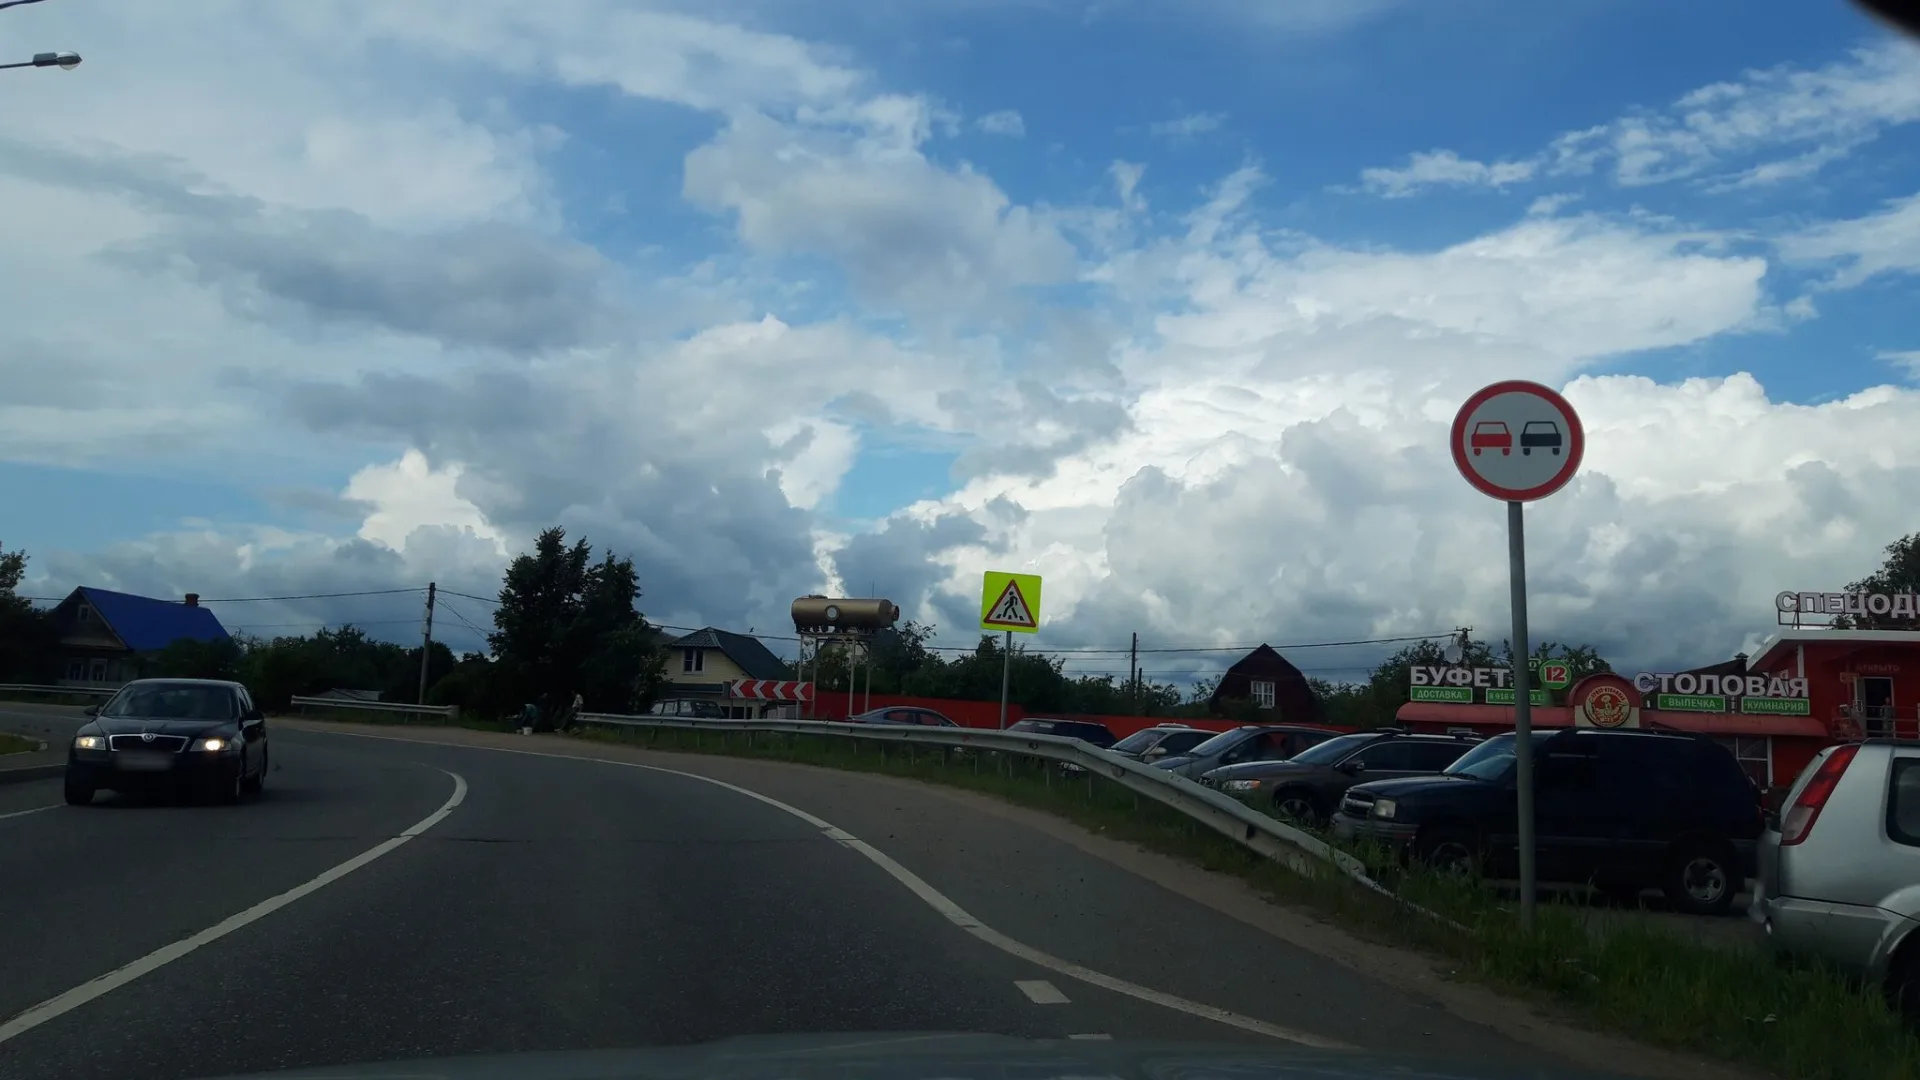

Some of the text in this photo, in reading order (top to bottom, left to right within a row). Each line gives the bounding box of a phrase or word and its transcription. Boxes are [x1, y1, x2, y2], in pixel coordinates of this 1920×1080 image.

[1775, 591, 1920, 619] СПЕЦОД
[1410, 666, 1510, 687] БУФЕТ
[1544, 665, 1567, 683] 12
[1634, 672, 1809, 698] СТОЛОВАЯ
[1669, 698, 1716, 709] ВЫПЕЧКА
[1747, 700, 1805, 712] КУЛИНАРИЯ
